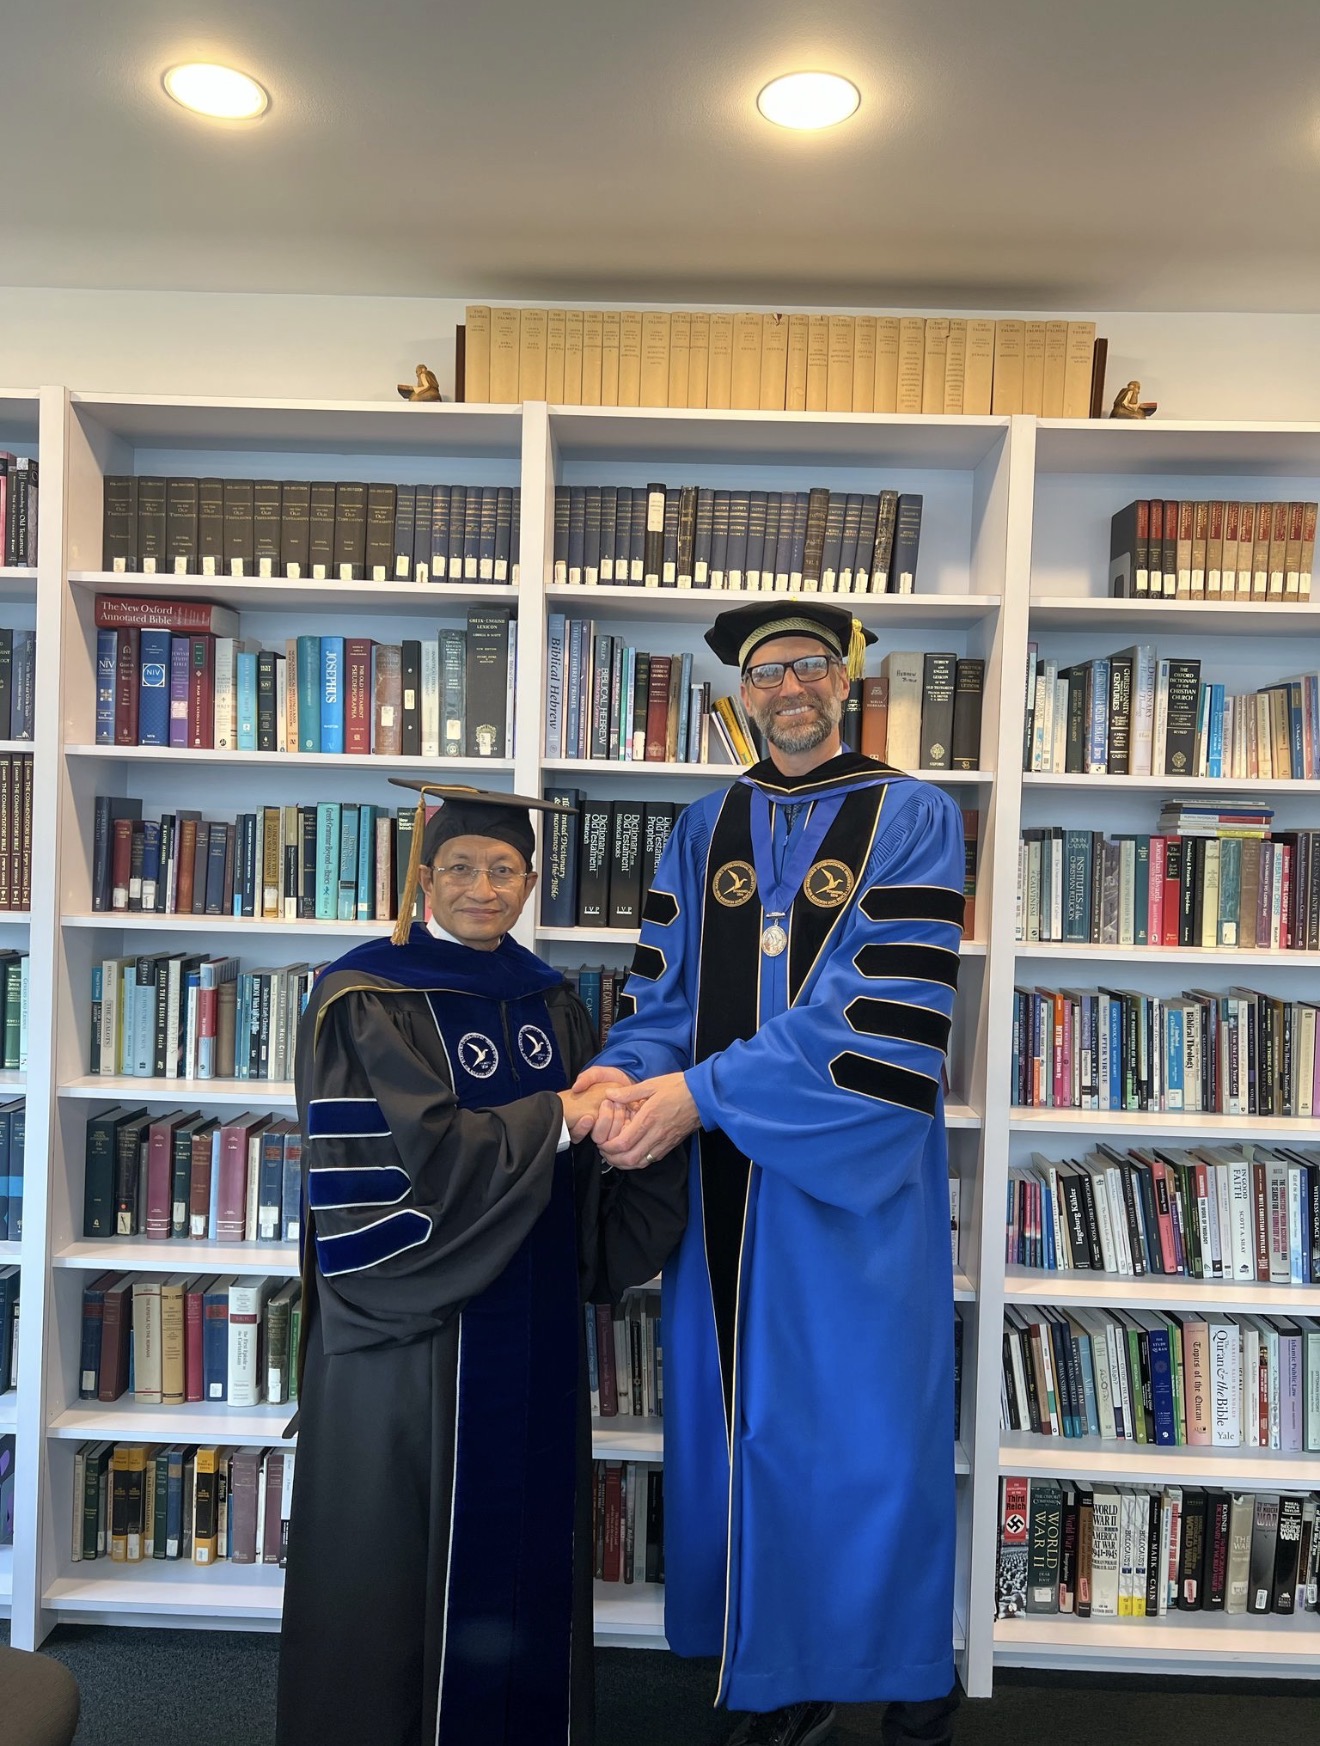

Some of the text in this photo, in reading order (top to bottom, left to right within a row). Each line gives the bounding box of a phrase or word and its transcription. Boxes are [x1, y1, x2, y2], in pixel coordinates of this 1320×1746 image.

[101, 602, 172, 615] The New Oxford
[101, 613, 172, 624] Annotated Bible
[326, 651, 336, 703] JOSEPHUS
[550, 638, 560, 729] Biblical Hebrew
[1146, 666, 1154, 718] DICTIONARY
[1094, 672, 1105, 743] CHRISTIANITY WESTERN THOUGHT
[599, 708, 608, 745] HEBREW
[589, 830, 598, 871] Testament
[597, 814, 607, 856] Dictionary
[622, 830, 630, 871] Testament
[629, 814, 639, 856] Dictionary
[646, 816, 655, 852] Prophets
[549, 854, 558, 862] of
[559, 837, 568, 878] Dictionary
[603, 979, 612, 990] THE
[603, 992, 612, 1012] CANON
[1186, 1012, 1195, 1069] Biblical Theology
[1124, 1167, 1132, 1206] THEOLOGICAL
[1071, 1213, 1084, 1244] Ingeburg
[1193, 1342, 1201, 1367] Topics
[1085, 1377, 1093, 1395] Allah
[1194, 1381, 1202, 1392] the
[1217, 1368, 1228, 1426] & the Bible
[1093, 1505, 1118, 1514] WORLD
[1093, 1515, 1116, 1526] WAR II
[1034, 1511, 1046, 1567] WAR II
[1046, 1511, 1059, 1568] WORLD
[1065, 1514, 1075, 1548] World War
[1093, 1532, 1118, 1541] AMERICA
[1093, 1541, 1116, 1549] AT WAR
[1185, 1516, 1194, 1548] WORLD
[1214, 1541, 1220, 1549] OF
[1185, 1549, 1193, 1567] WAR
